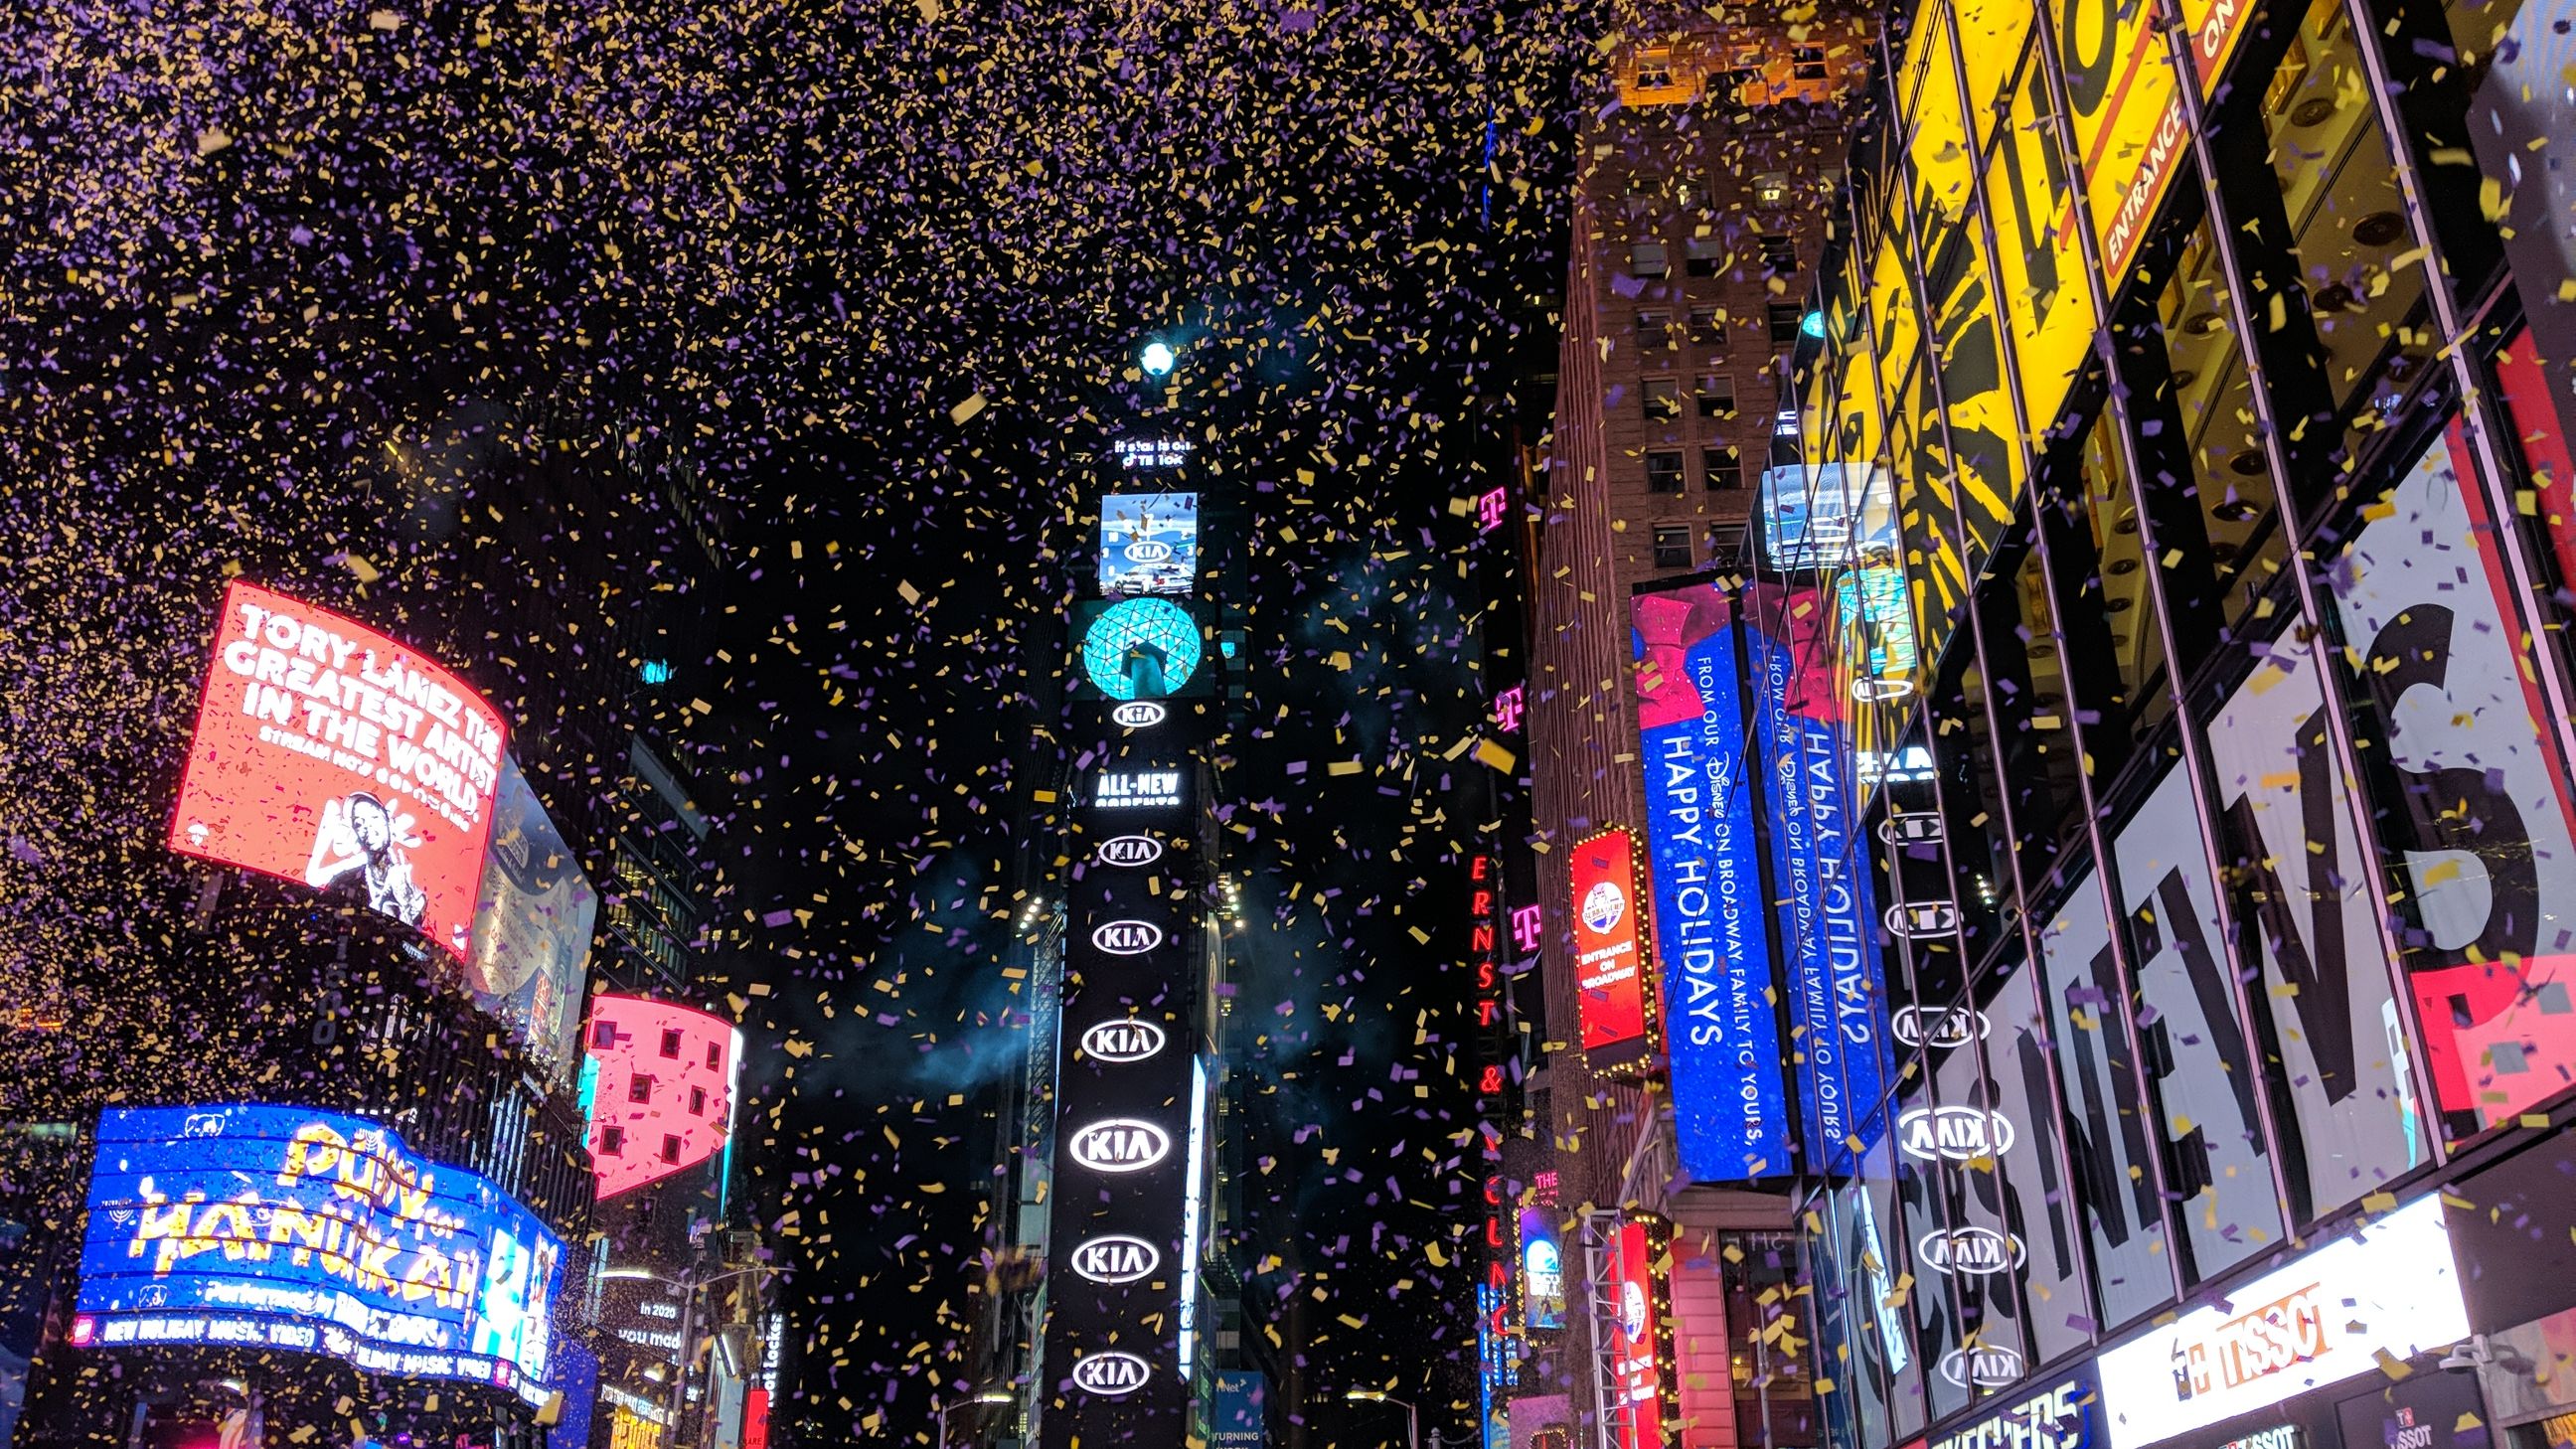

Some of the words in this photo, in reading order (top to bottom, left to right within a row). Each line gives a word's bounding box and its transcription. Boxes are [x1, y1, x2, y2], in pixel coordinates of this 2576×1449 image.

[2108, 97, 2185, 265] ENTRANCE
[1132, 546, 1163, 559] KIA
[241, 603, 358, 670] TORY
[361, 649, 462, 730] LANEZ
[464, 707, 500, 764] THE
[1697, 657, 1714, 704] FROM
[224, 640, 424, 739] GREATEST
[422, 722, 498, 796] ARTIST
[242, 682, 293, 725] IN
[302, 700, 381, 759] THE
[1122, 708, 1157, 722] KIA
[1702, 710, 1719, 747] OUR
[1097, 773, 1179, 796] ALL-NEW
[1663, 735, 1703, 845] HAPPY
[1109, 842, 1151, 860] KIA
[1714, 823, 1731, 854] ON
[1717, 859, 1744, 961] BROADWAY
[1104, 928, 1150, 947] KIA
[1675, 860, 1723, 1046] HOLIDAYS
[2017, 602, 2540, 1282] NEWS
[1600, 958, 1616, 972] ON
[1730, 968, 1752, 1033] FAMILY
[1096, 1027, 1152, 1051] KIA
[1736, 1040, 1754, 1067] TO
[1087, 1130, 1152, 1161] KIA
[1087, 1245, 1148, 1274] KIA
[640, 1302, 651, 1315] In
[652, 1304, 676, 1319] 2020
[649, 1332, 682, 1350] mad
[1086, 1361, 1137, 1385] KIA
